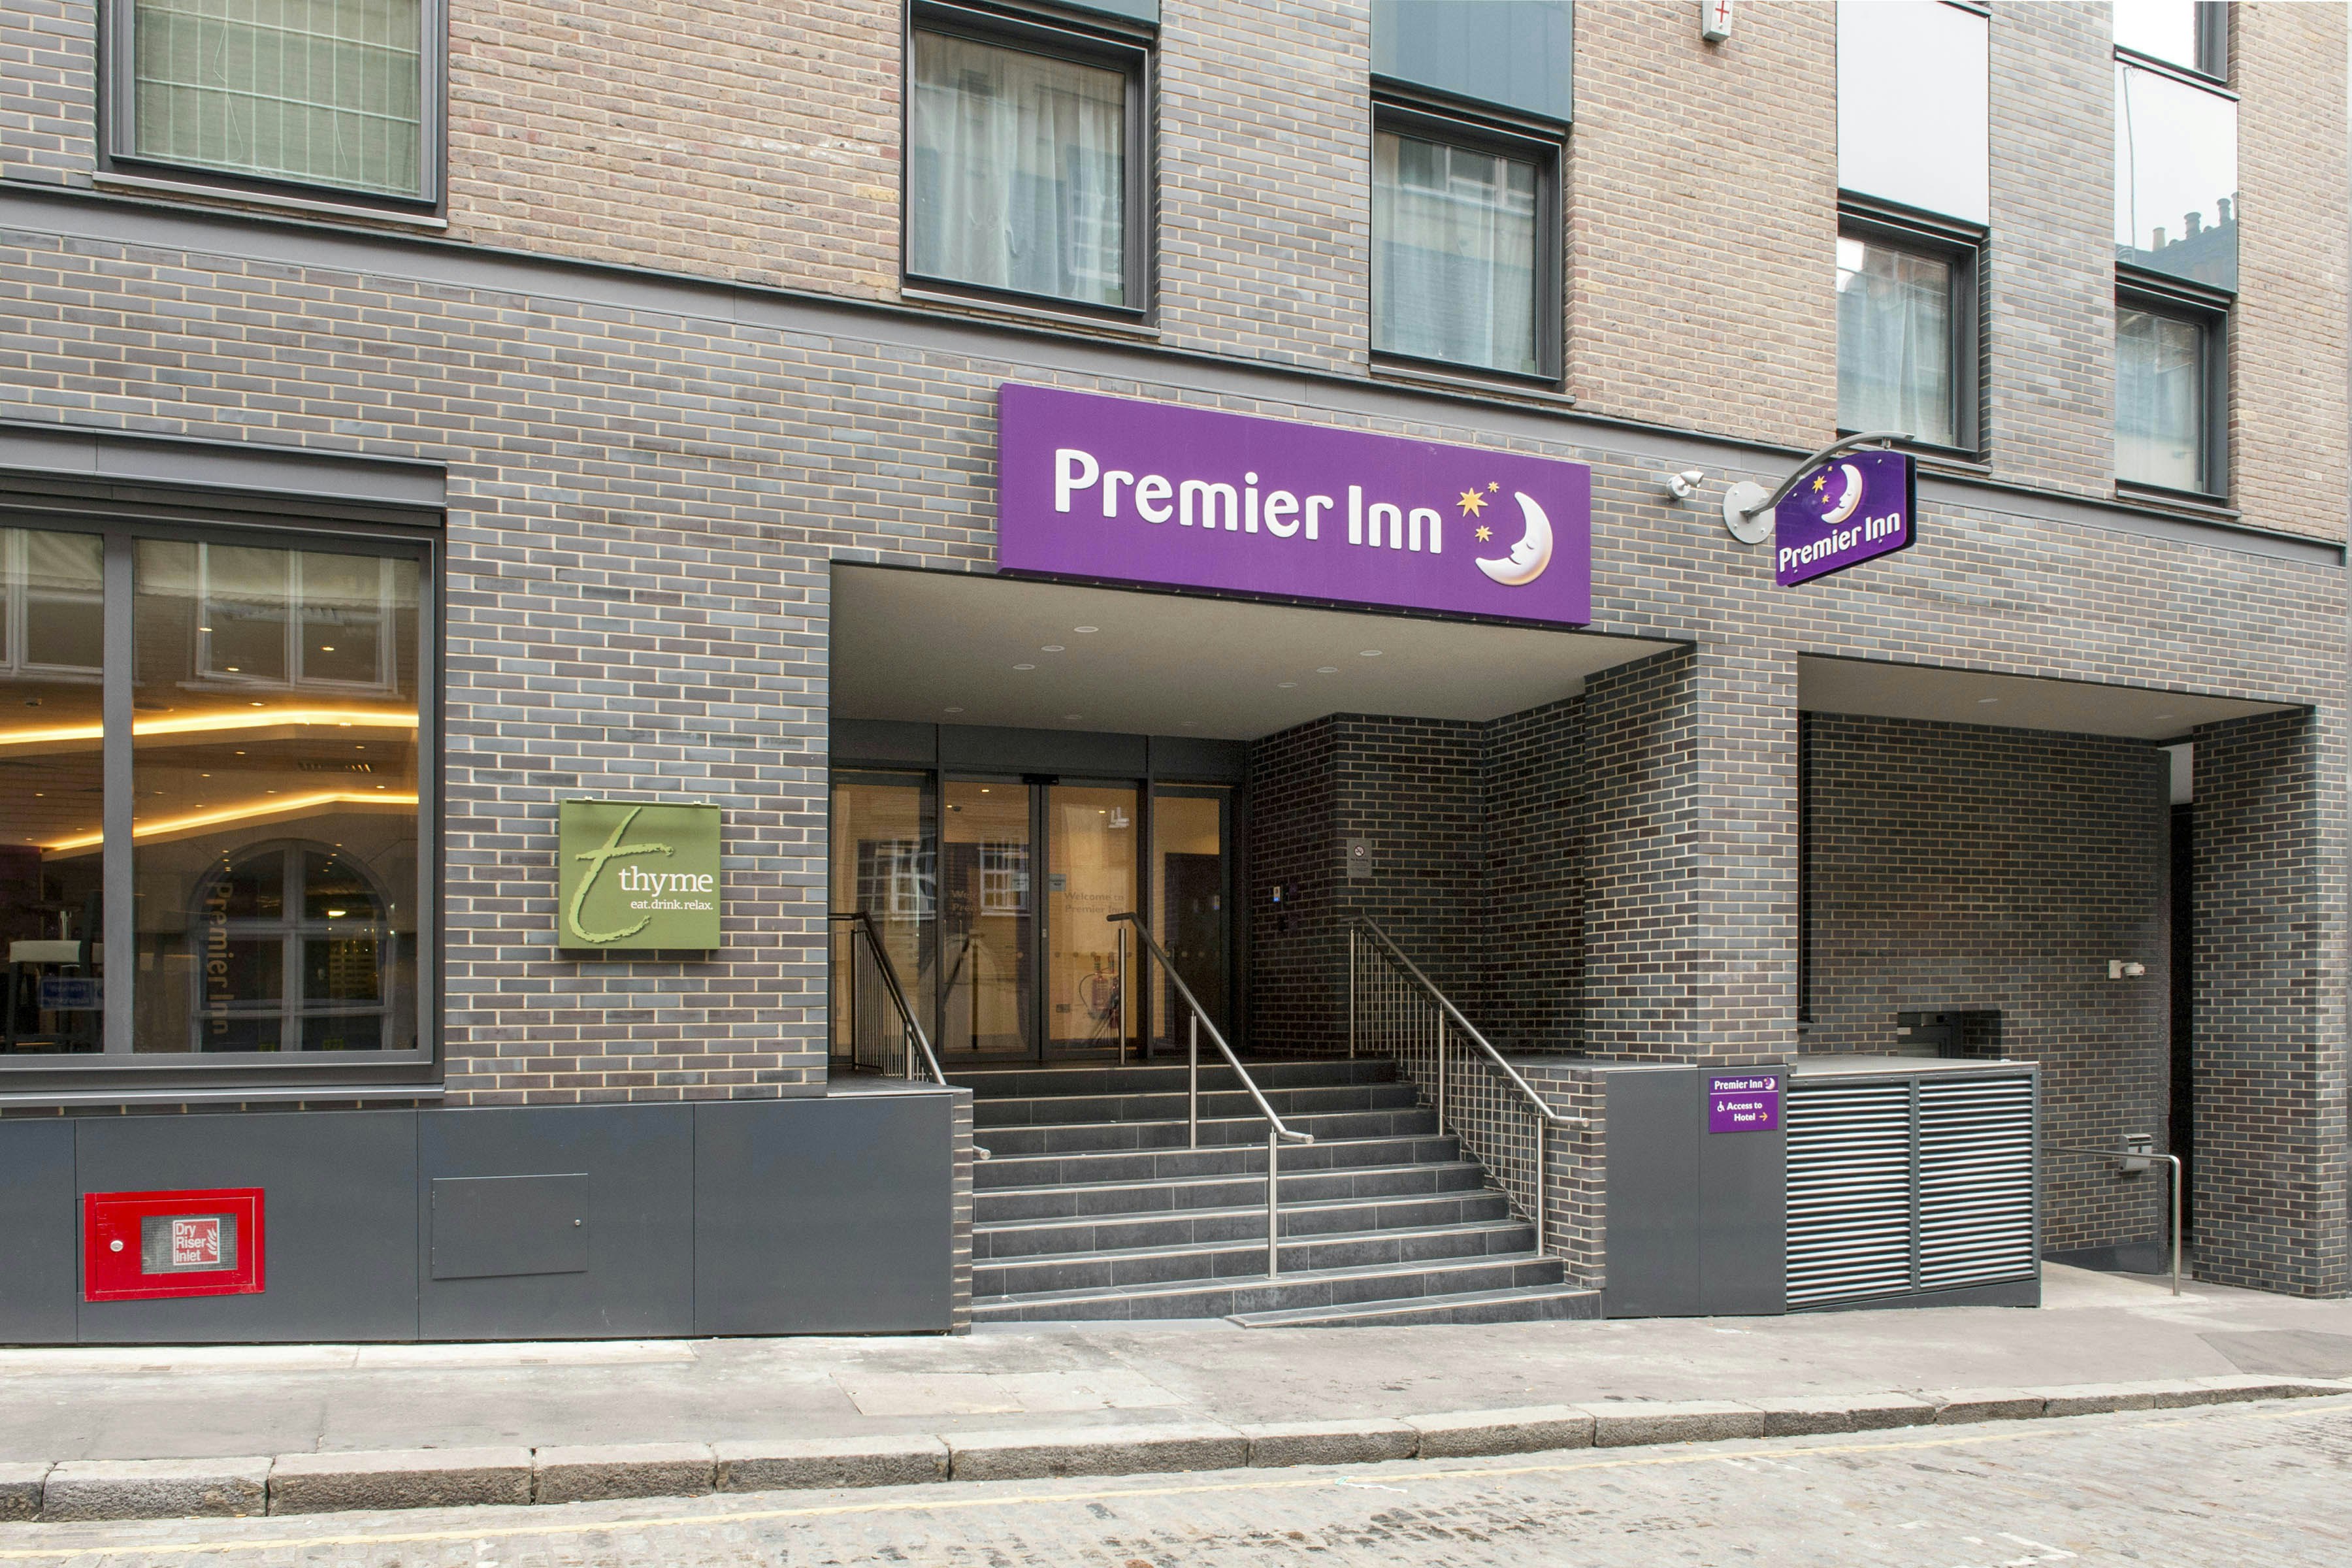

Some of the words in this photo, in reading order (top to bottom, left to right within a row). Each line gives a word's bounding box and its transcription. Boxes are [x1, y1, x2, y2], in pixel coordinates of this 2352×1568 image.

[1054, 448, 1333, 541] Premier
[1348, 485, 1442, 555] Inn
[1779, 525, 1862, 573] Premier
[1865, 512, 1901, 542] Inn
[617, 865, 714, 898] thyme
[1064, 890, 1112, 900] Welcome
[630, 898, 714, 911] eat.drink.relax.
[1065, 904, 1105, 913] Premier
[206, 882, 234, 988] Premier
[208, 994, 235, 1034] Inn
[1714, 1080, 1748, 1090] Premier
[1749, 1079, 1763, 1088] Inn
[1727, 1102, 1753, 1111] Access
[1734, 1113, 1756, 1121] Hotel
[176, 1222, 196, 1237] Dry
[176, 1236, 206, 1249] Riser
[176, 1249, 202, 1262] Inlet
